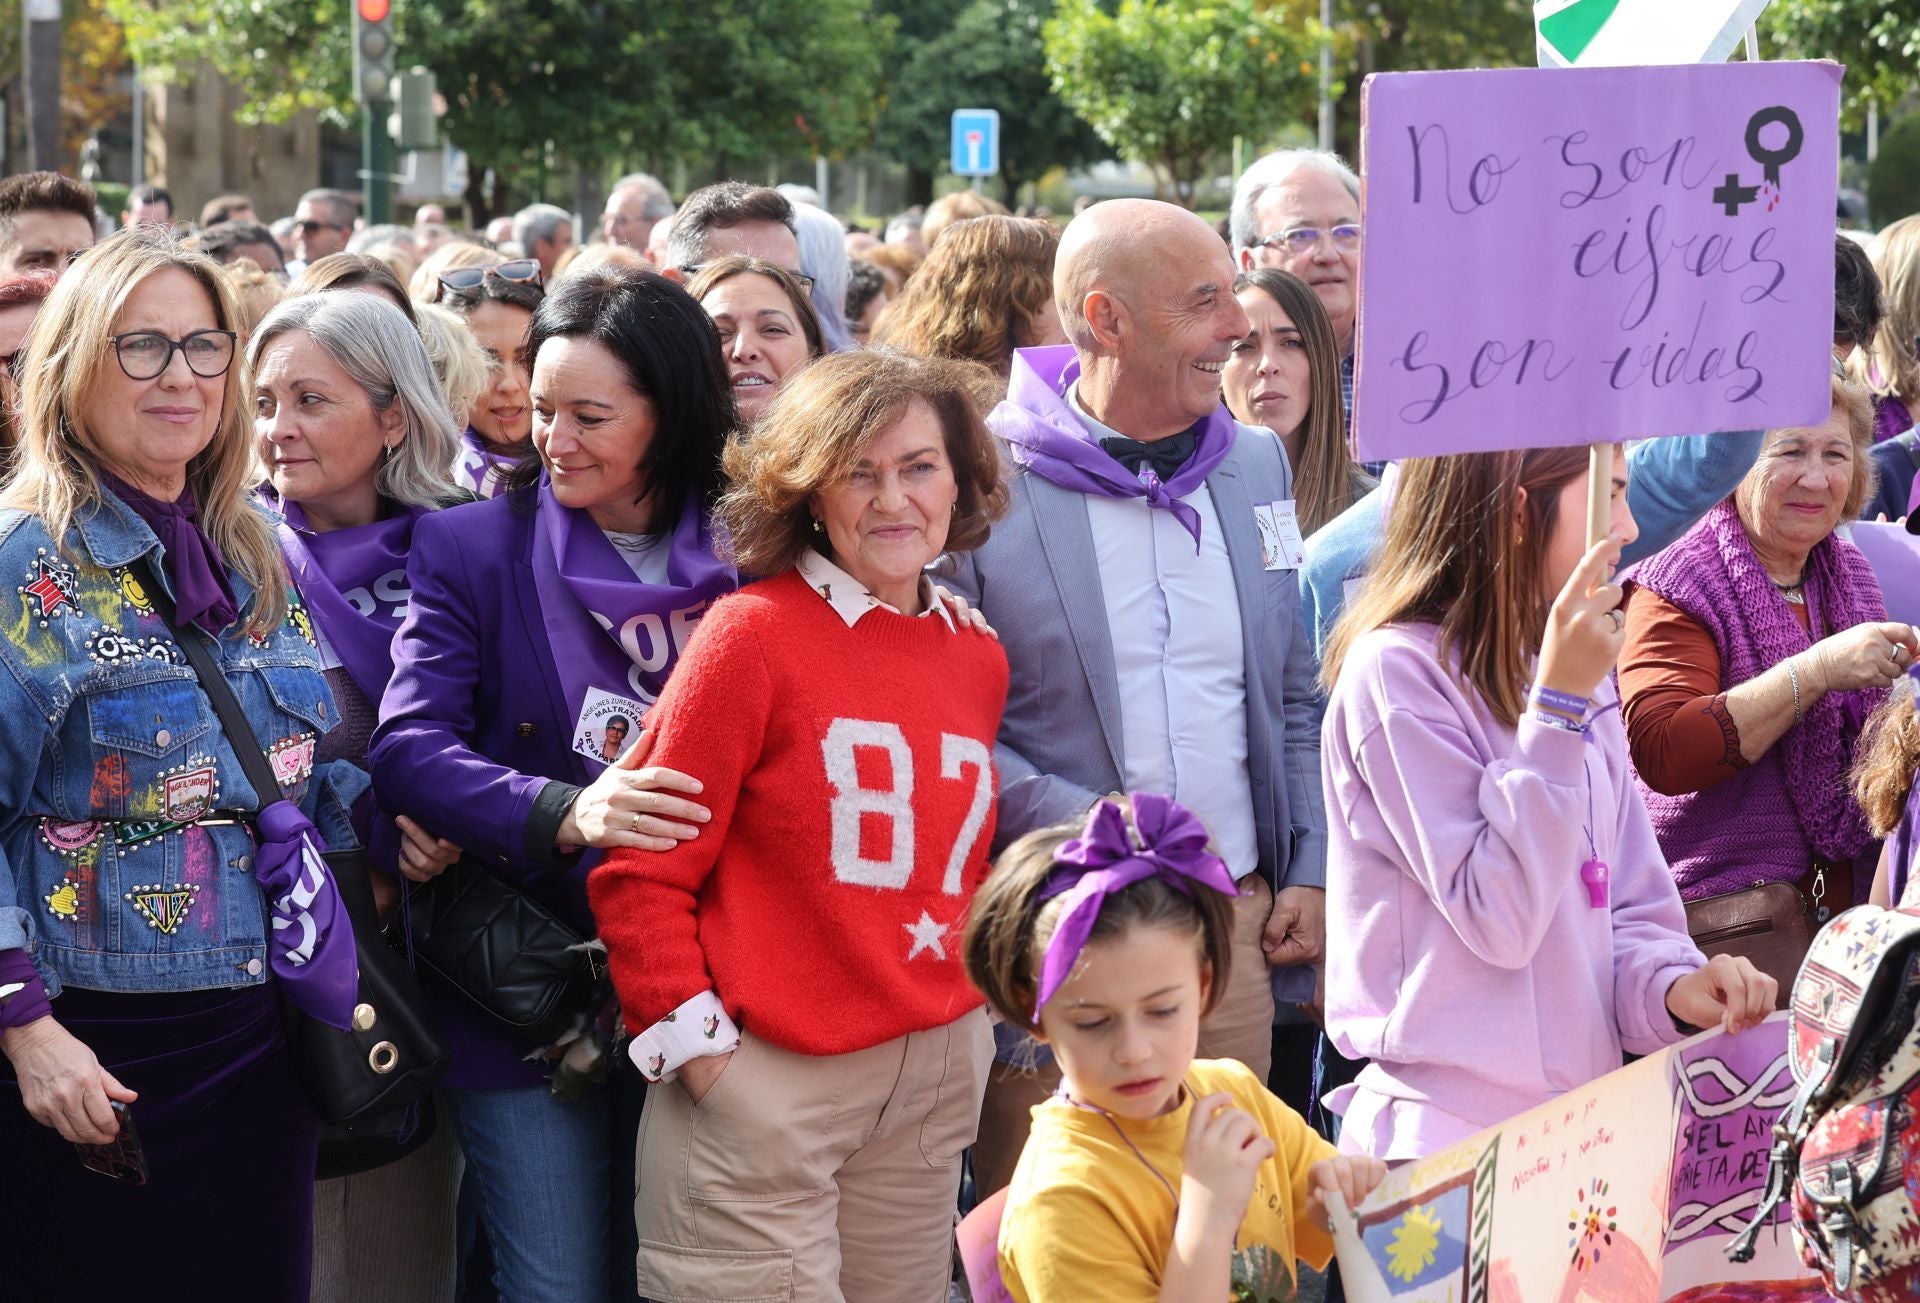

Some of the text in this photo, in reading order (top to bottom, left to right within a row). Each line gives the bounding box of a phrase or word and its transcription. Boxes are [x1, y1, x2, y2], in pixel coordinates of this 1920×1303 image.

[1406, 123, 1520, 215] No
[1601, 302, 1767, 405] vidas
[582, 698, 610, 721] ANGELINES
[611, 698, 635, 710] ZURERA
[584, 731, 619, 765] DESAPAR
[821, 717, 992, 895] 87
